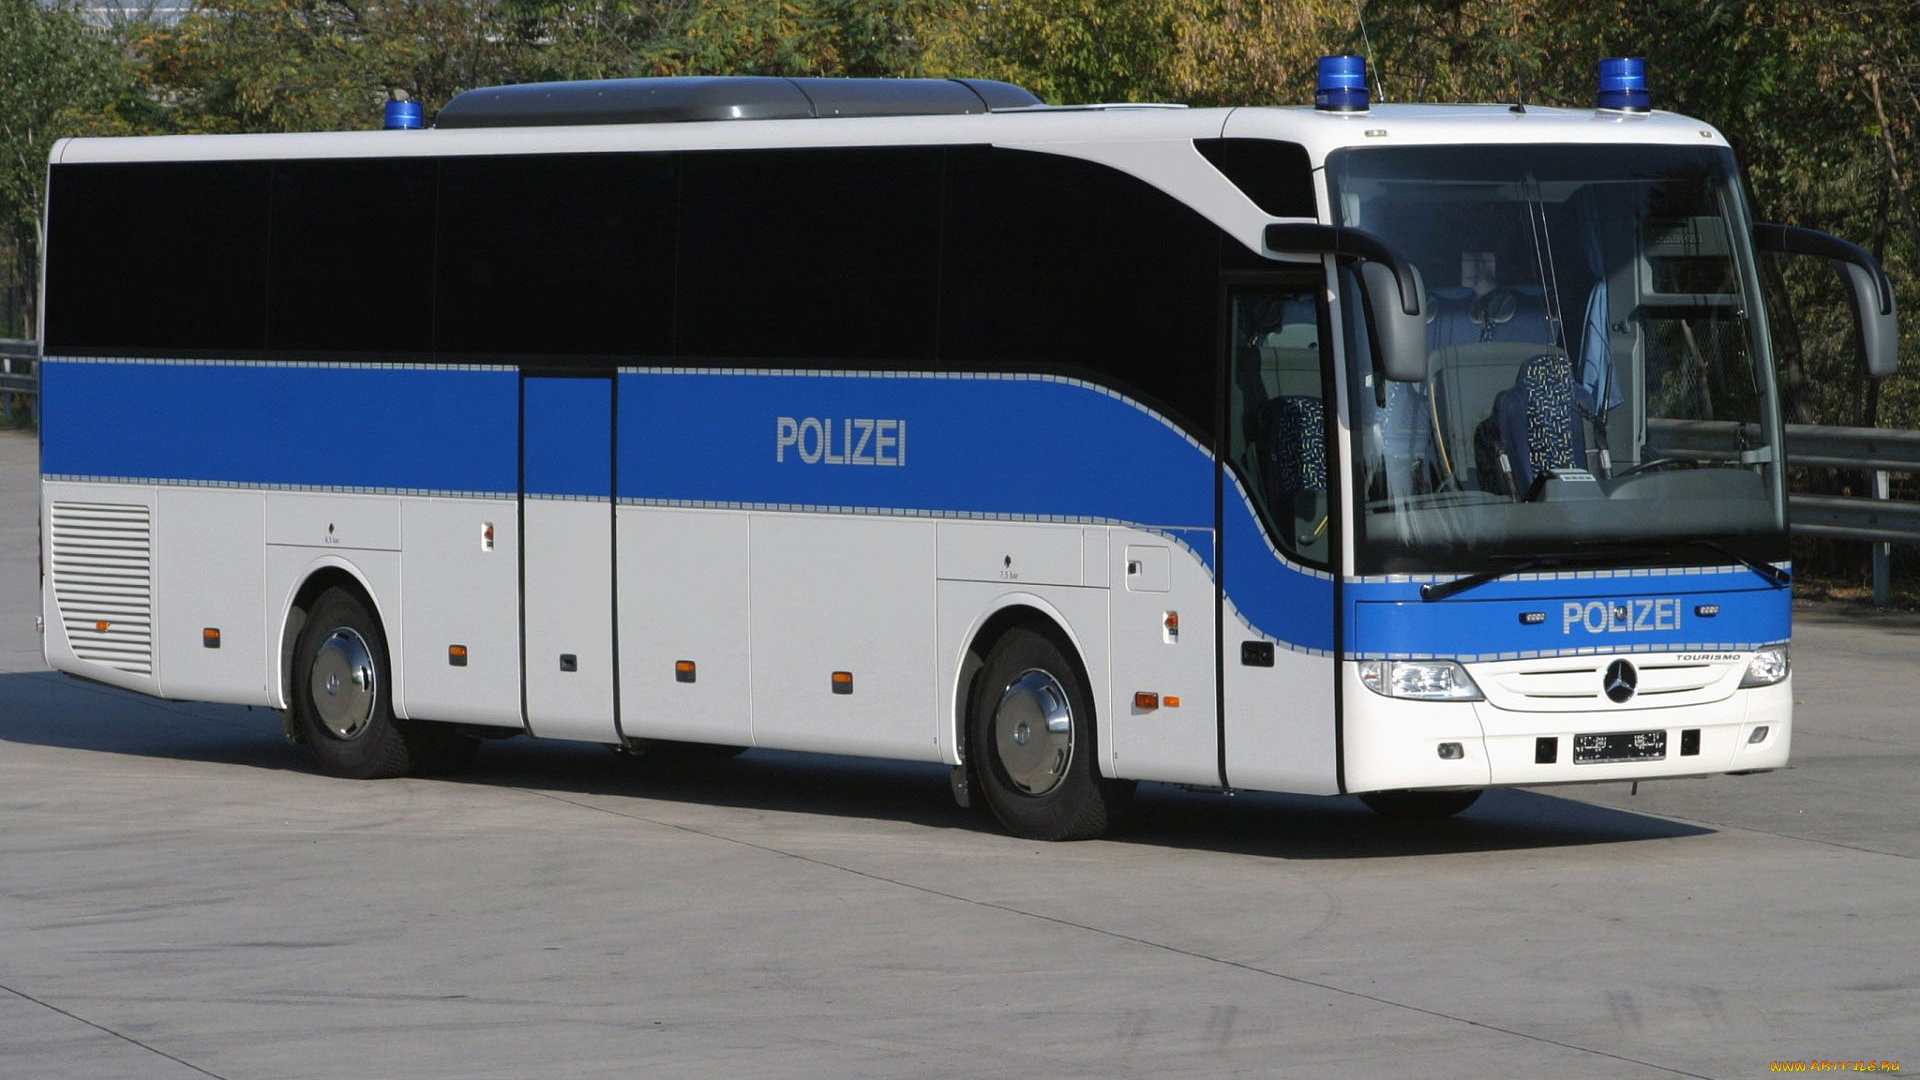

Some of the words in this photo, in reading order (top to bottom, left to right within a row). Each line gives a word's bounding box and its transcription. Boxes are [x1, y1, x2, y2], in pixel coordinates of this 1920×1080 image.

[776, 416, 906, 466] POLIZEI
[1010, 571, 1019, 579] bar
[1562, 598, 1681, 634] POLIZEI
